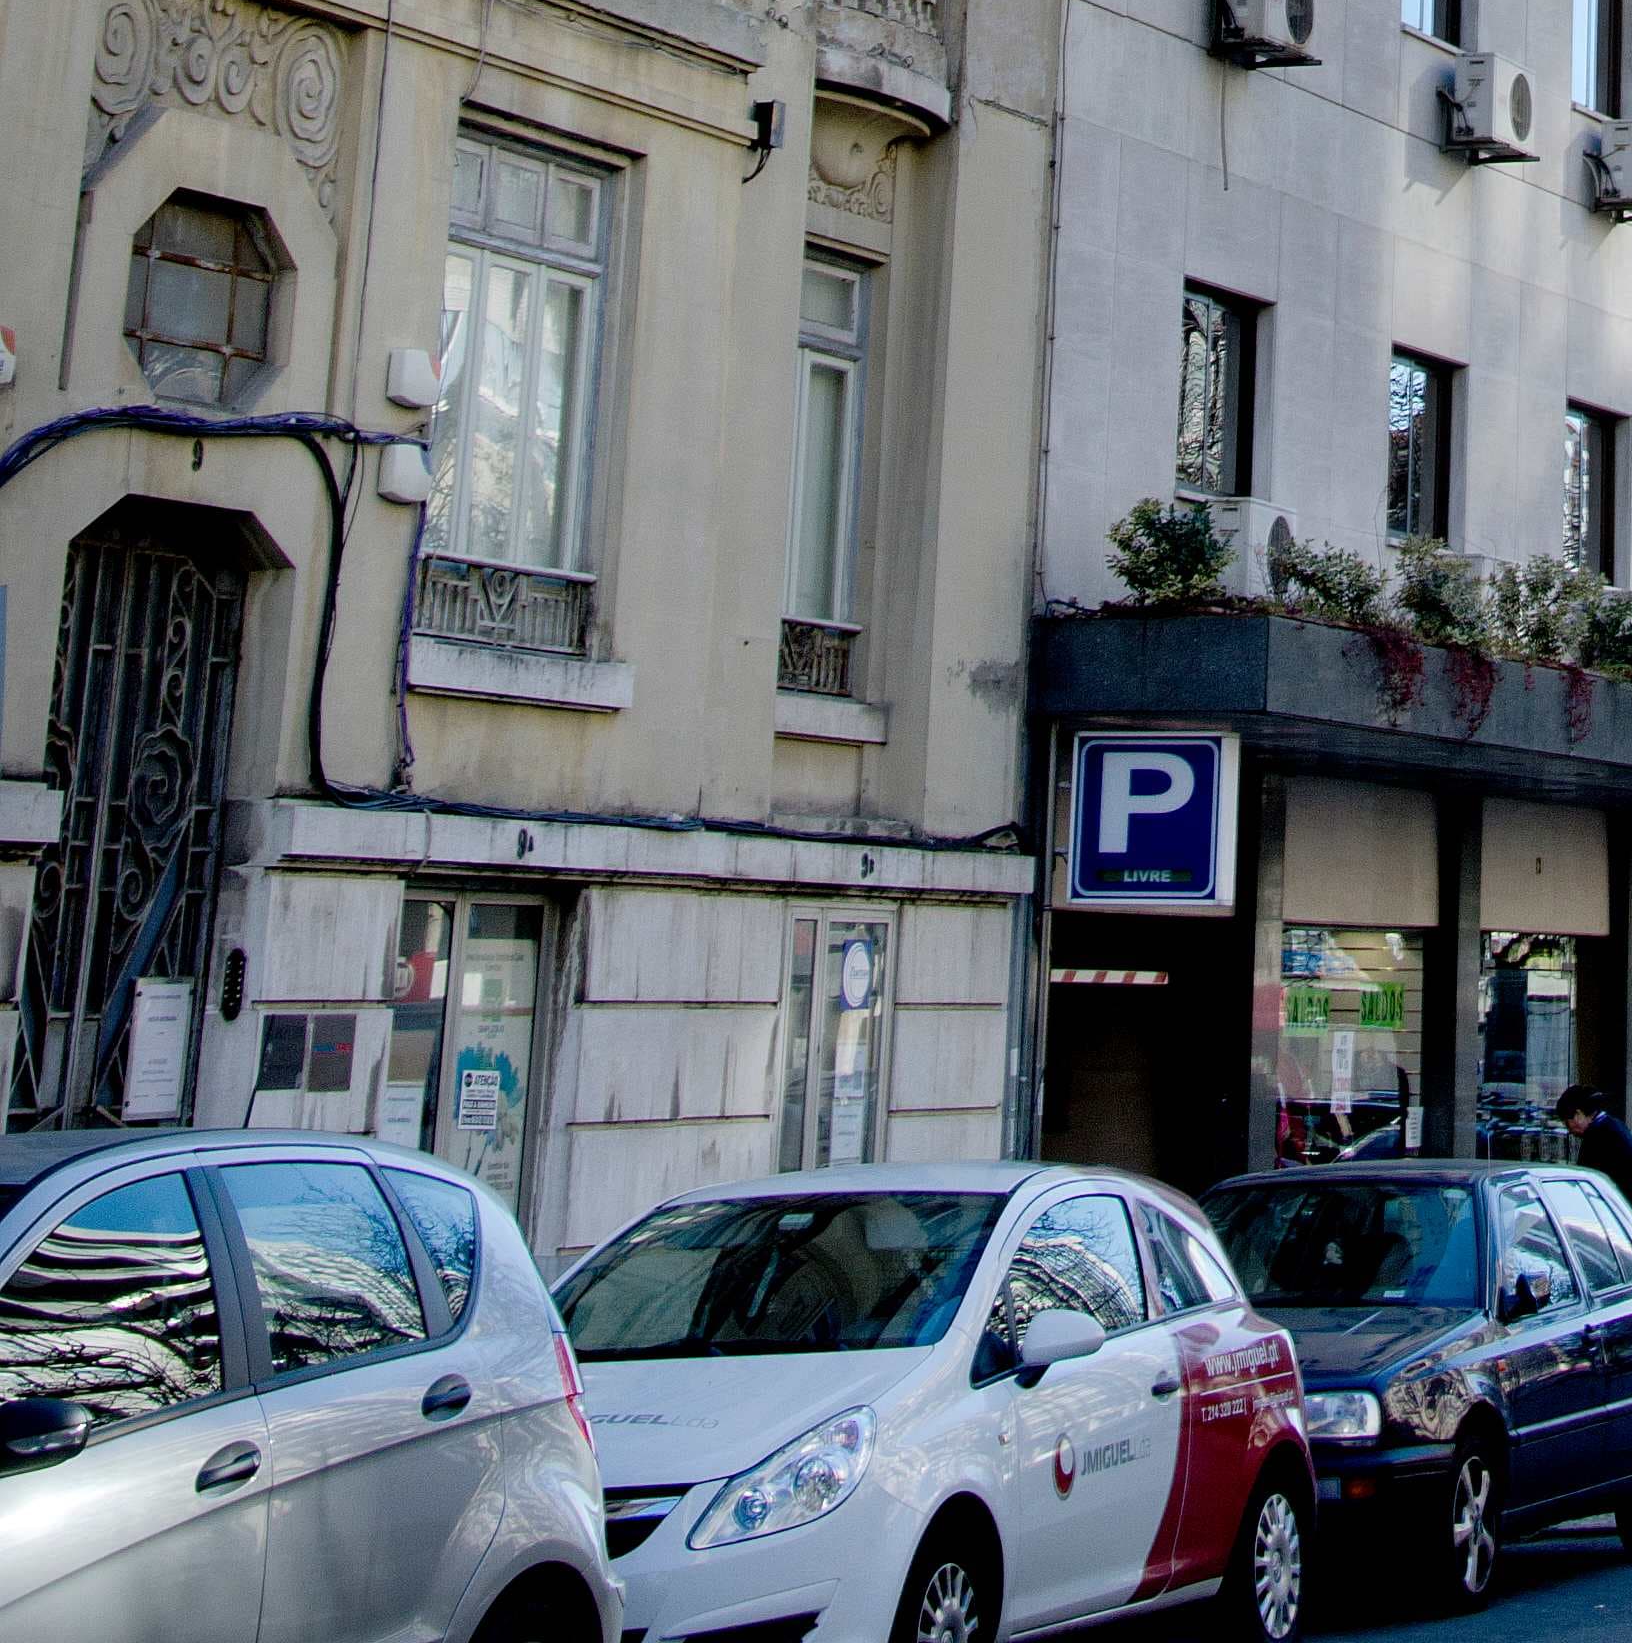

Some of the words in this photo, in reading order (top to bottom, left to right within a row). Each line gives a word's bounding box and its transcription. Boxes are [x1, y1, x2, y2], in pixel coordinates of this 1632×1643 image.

[1098, 751, 1196, 854] P
[1123, 869, 1173, 883] LIVRE
[1361, 989, 1404, 1022] SALDOS
[587, 1413, 669, 1425] GUEL
[1081, 1437, 1136, 1476] JMIGUEL
